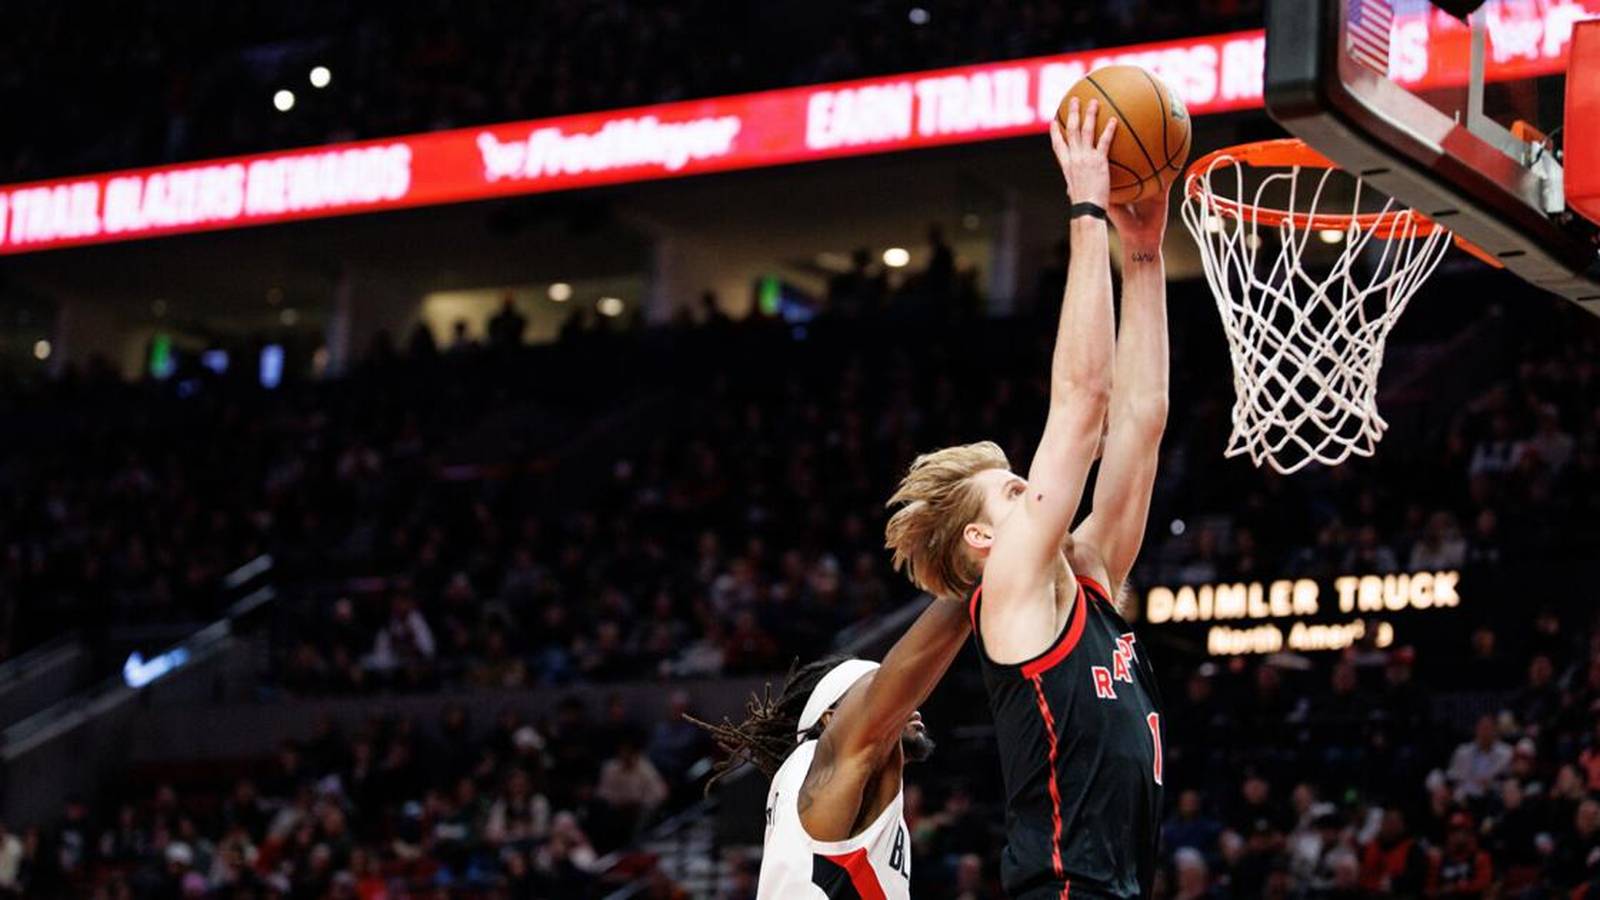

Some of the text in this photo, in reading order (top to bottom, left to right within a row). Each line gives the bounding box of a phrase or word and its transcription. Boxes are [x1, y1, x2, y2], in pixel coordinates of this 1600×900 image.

[805, 82, 913, 150] EARN
[916, 65, 1036, 136] TRAIL
[10, 181, 99, 244] TRAIL
[103, 163, 245, 233] BLAZERS
[245, 143, 412, 216] REWARDS
[1147, 570, 1461, 624] DAIMLER TRUCK
[1208, 623, 1283, 655] North
[1147, 711, 1163, 786] 1
